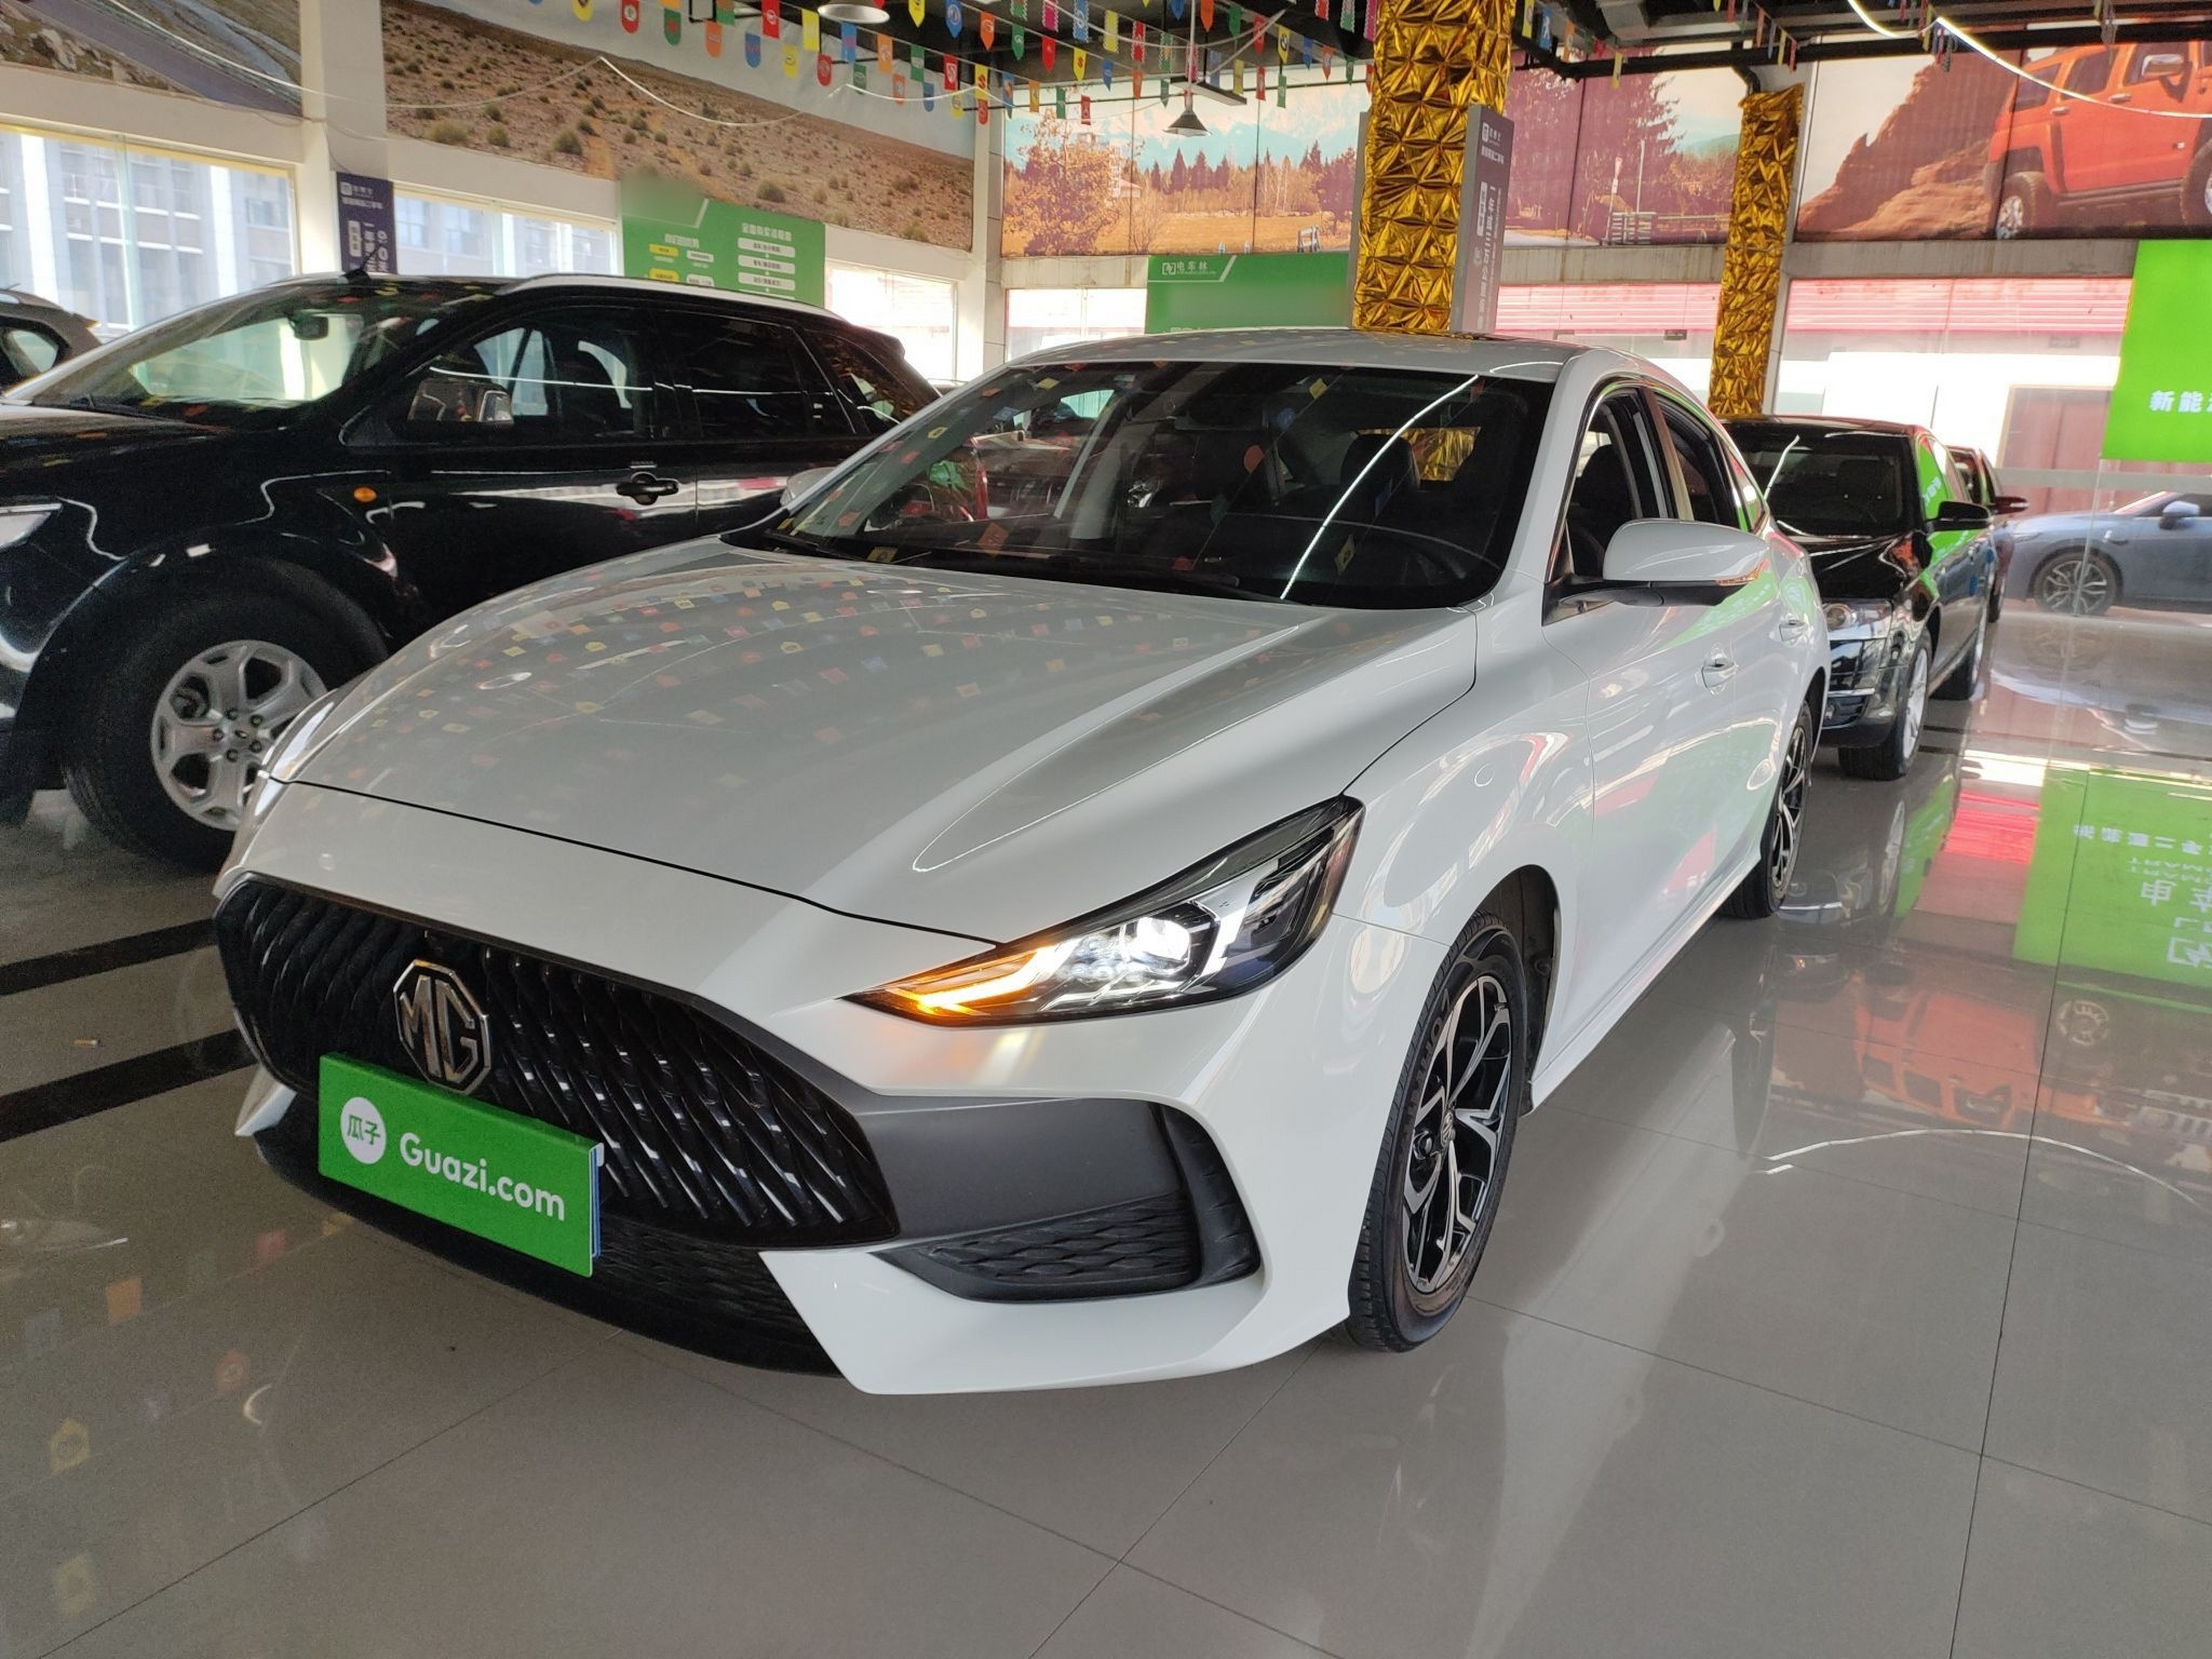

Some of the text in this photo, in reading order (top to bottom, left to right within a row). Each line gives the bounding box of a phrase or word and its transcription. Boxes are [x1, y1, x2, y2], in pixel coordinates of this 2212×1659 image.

[2149, 390, 2212, 413] 新能
[400, 974, 478, 1084] MG
[347, 1115, 381, 1145] 瓜子
[400, 1132, 565, 1221] Guazi.com
